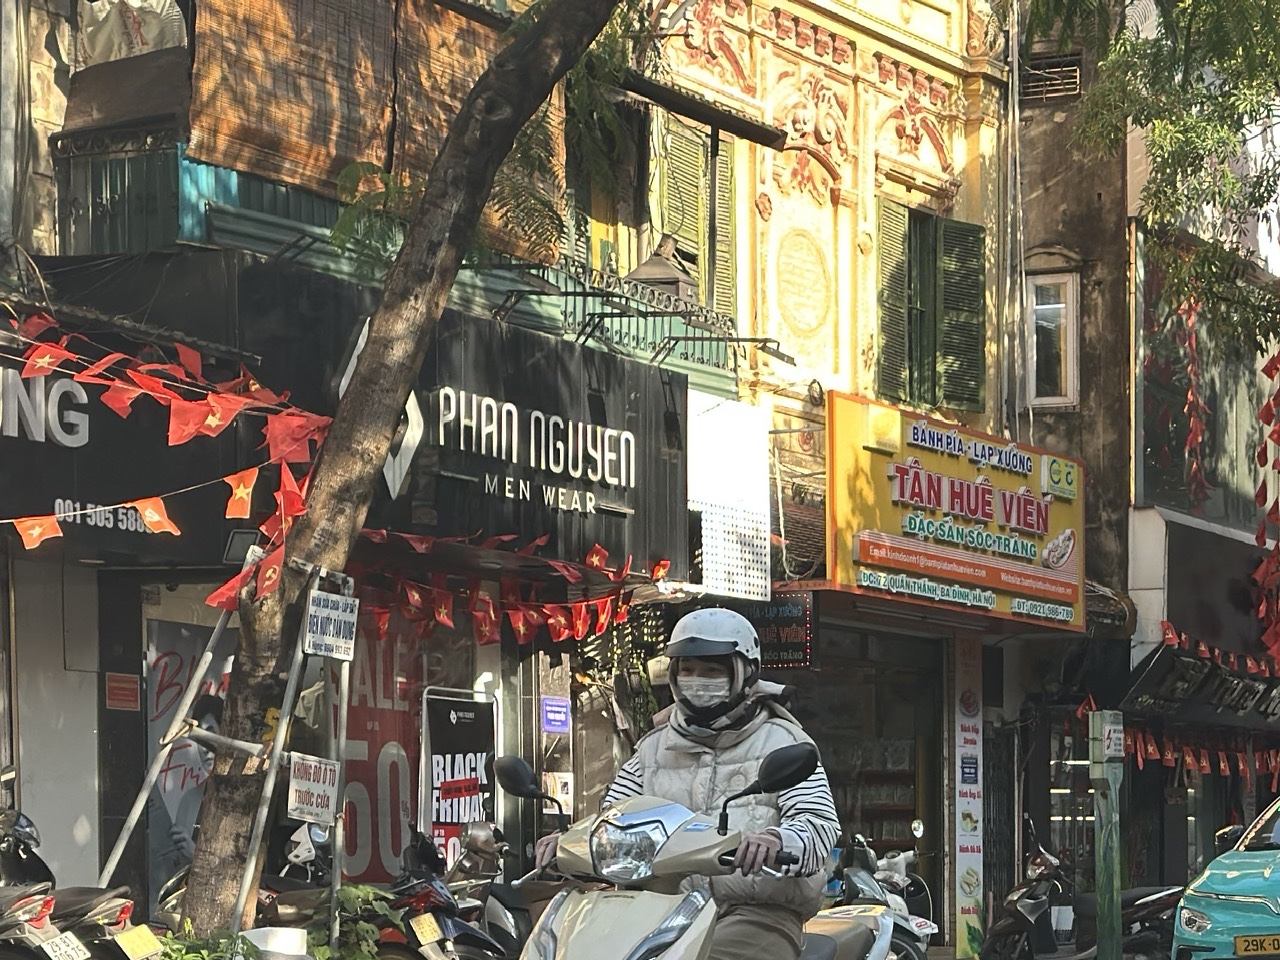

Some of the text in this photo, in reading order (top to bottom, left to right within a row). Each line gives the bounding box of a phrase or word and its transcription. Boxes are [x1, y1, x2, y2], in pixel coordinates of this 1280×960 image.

[0, 366, 90, 448] NG
[439, 386, 636, 489] PHAN NGUYEN
[911, 421, 944, 450] BÁNH
[945, 430, 965, 456] PÍA
[973, 441, 995, 468] LẠP
[54, 498, 82, 525] 091
[85, 503, 114, 529] 505
[484, 472, 597, 514] MEN WEAR
[894, 458, 1050, 535] TÂN HUÊ VIÊN
[907, 512, 1038, 559] ĐẶC SẢN SÓC TRĂNG
[940, 585, 951, 598] BA
[972, 588, 983, 603] HÀ
[983, 590, 996, 609] NỘI
[432, 752, 488, 788] BLACK
